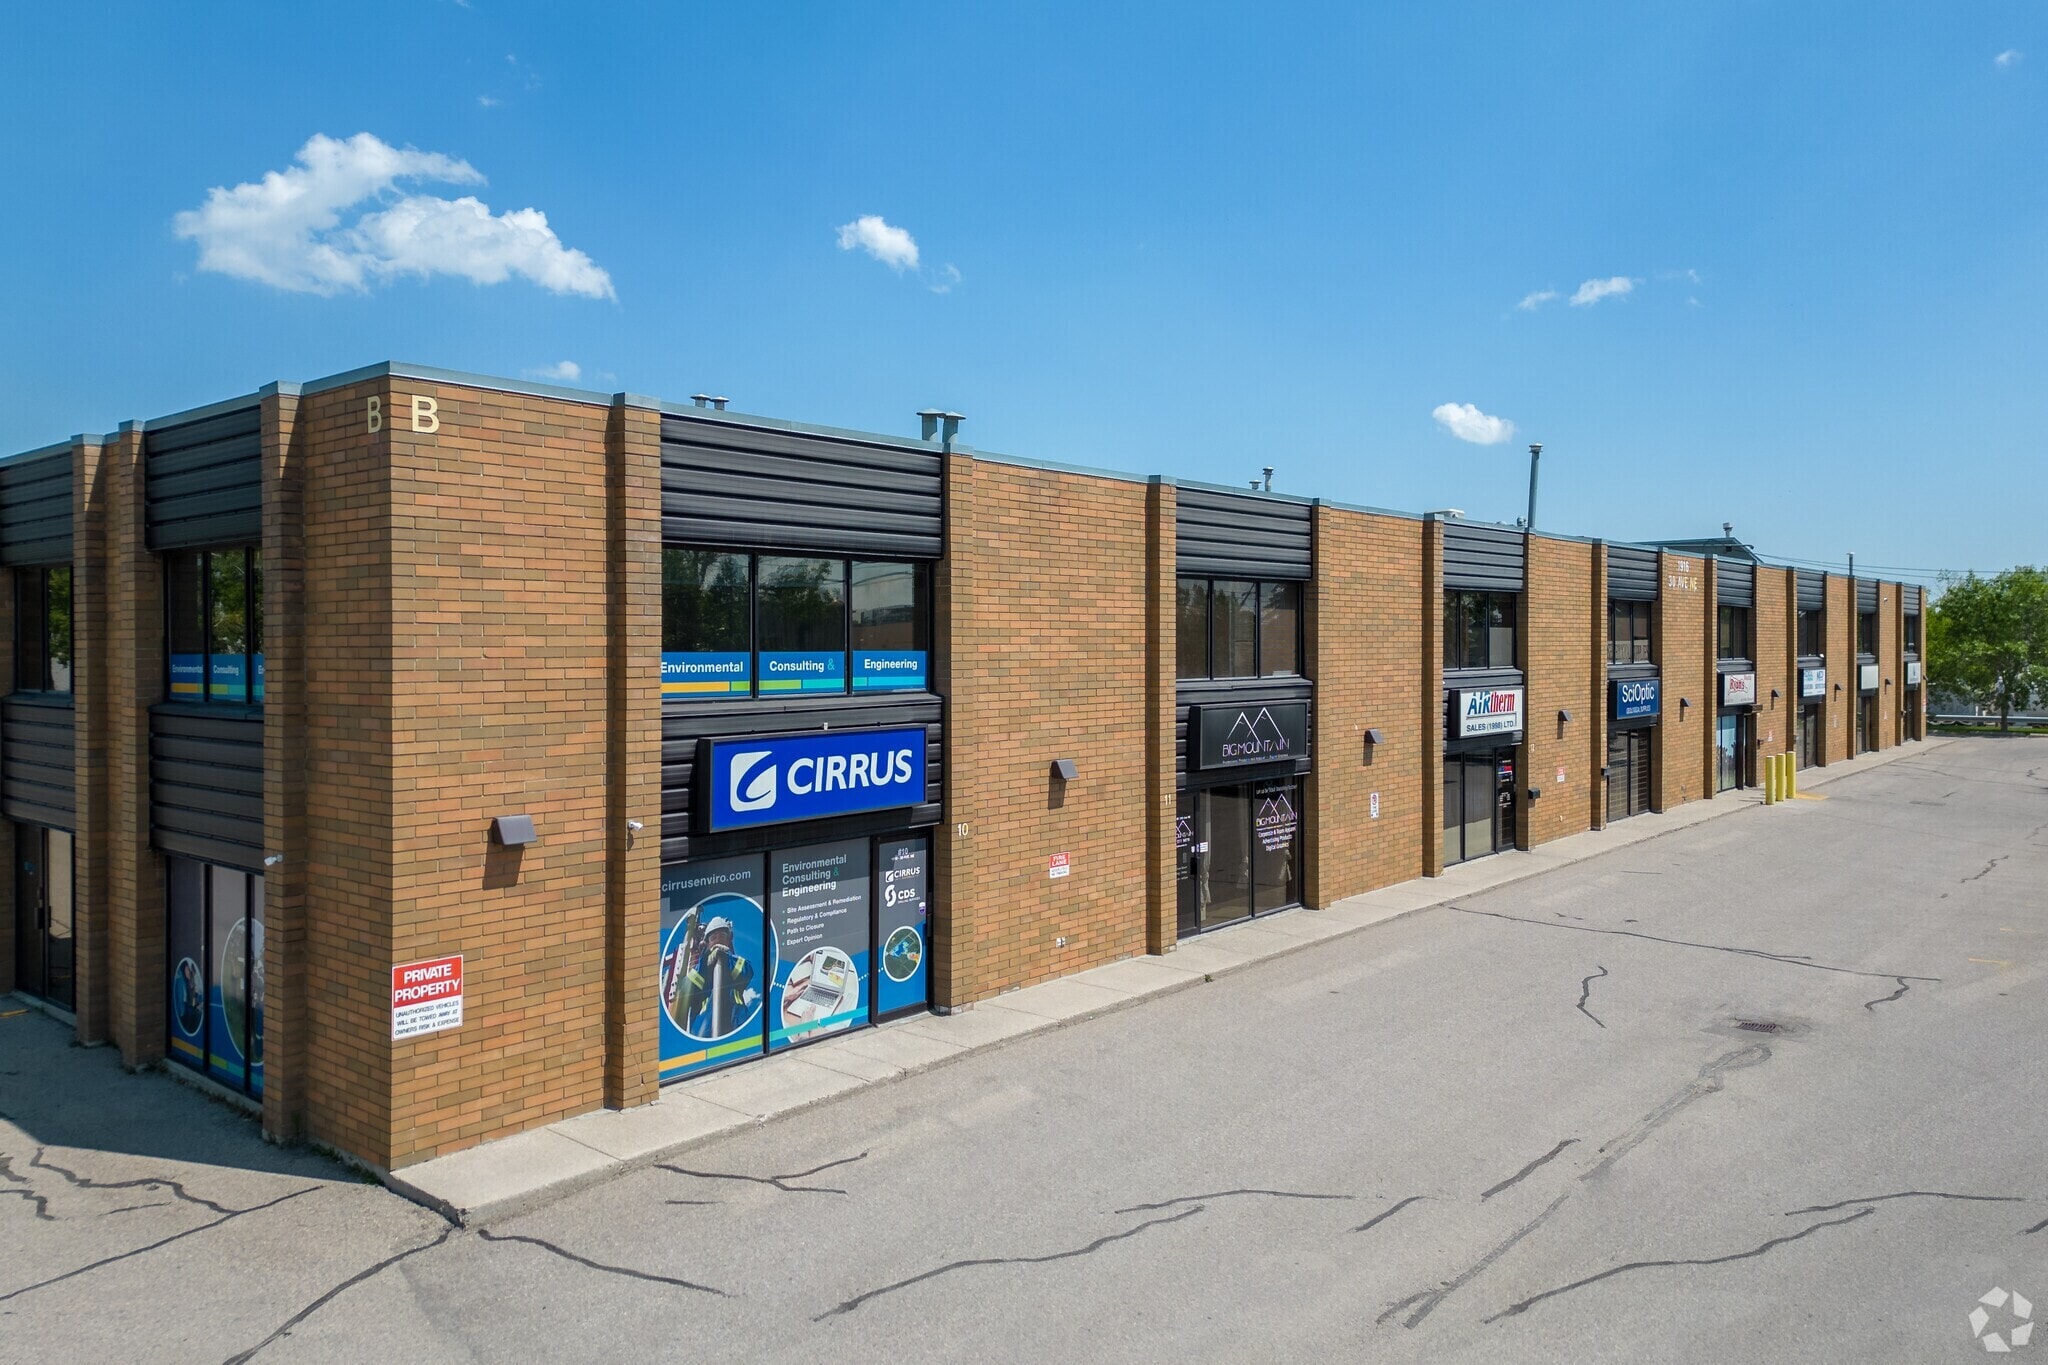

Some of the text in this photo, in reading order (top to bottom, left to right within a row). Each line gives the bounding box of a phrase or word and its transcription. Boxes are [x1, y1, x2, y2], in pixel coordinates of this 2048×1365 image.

[367, 395, 382, 434] B
[412, 394, 440, 434] B
[660, 661, 744, 673] Environmental
[769, 658, 835, 673] Consulting &
[864, 658, 918, 671] Engineering
[1622, 682, 1655, 705] SciOptic
[1466, 723, 1486, 732] SALES
[787, 749, 913, 795] CIRRUS
[1164, 794, 1172, 805] 11
[957, 823, 969, 836] 10
[782, 854, 847, 873] Environmental
[782, 867, 839, 885] Consulting &
[894, 866, 920, 878] CIRRUS
[661, 870, 751, 892] cirrusenviro.com
[782, 881, 837, 897] Engineering
[897, 888, 916, 900] CDS
[797, 901, 827, 912] Assessment
[786, 914, 814, 925] Regulatory
[819, 908, 848, 918] Compliance
[805, 922, 825, 931] Closure
[786, 933, 823, 946] Expert Opinion
[404, 964, 452, 984] PRIVATE
[395, 978, 460, 1002] PROPERTY
[395, 1000, 459, 1018] UNAUTHORIZED VEHICLES
[394, 1026, 418, 1036] OWNERS
[418, 1023, 431, 1031] RISK
[437, 1017, 460, 1027] EXPENSE
[396, 1019, 409, 1027] WILL
[419, 1013, 437, 1021] TOWED
